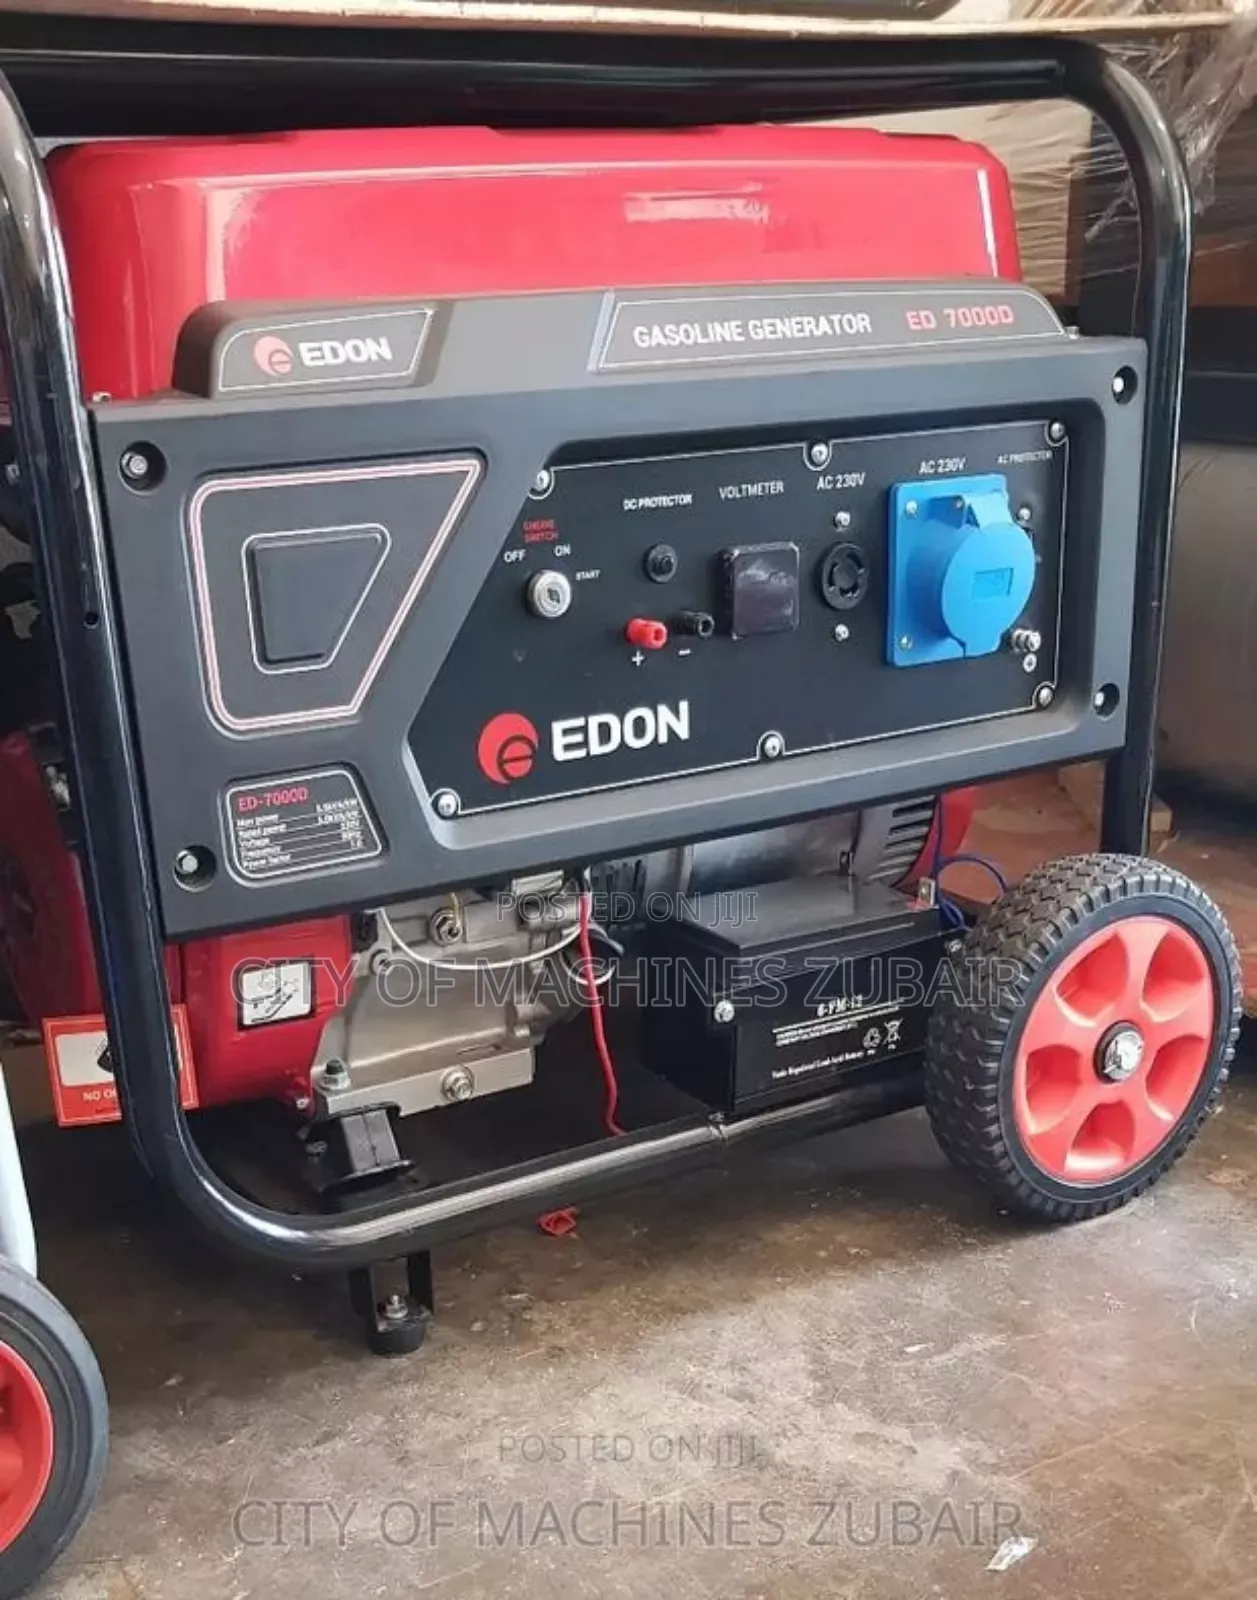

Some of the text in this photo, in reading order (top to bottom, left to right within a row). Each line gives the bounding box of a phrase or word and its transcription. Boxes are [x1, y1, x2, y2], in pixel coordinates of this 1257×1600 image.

[632, 305, 1014, 348] GASOLINE GENERATOR ED 7000D
[298, 336, 393, 367] EDON
[919, 457, 966, 474] AC 230V
[816, 472, 865, 490] AC 230V
[719, 481, 784, 500] VOLTMETER
[623, 494, 693, 510] DC PROTECTOR
[504, 549, 526, 563] OFF
[554, 544, 571, 557] ON
[575, 570, 600, 581] START
[551, 698, 690, 762] EDON
